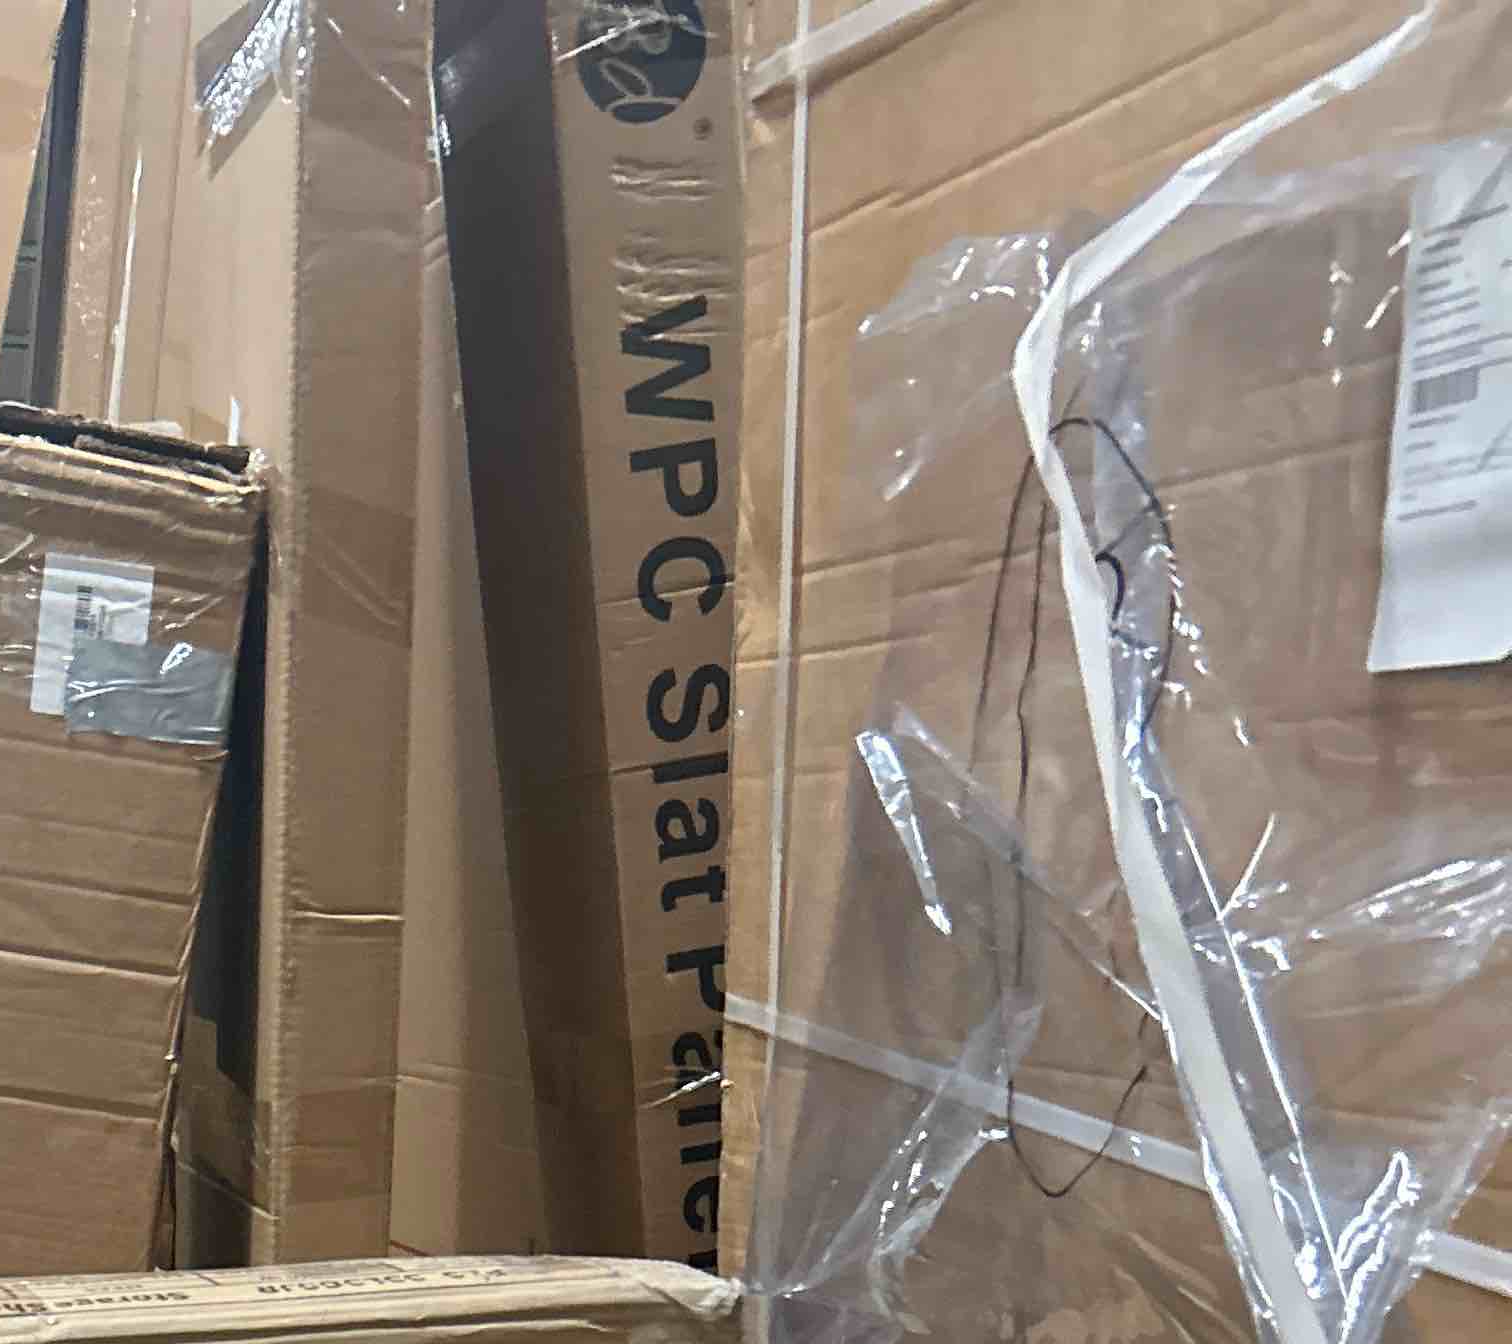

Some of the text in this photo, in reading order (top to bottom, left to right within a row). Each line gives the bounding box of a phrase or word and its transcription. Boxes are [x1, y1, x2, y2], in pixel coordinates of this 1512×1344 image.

[620, 295, 728, 623] WPC
[646, 663, 730, 912] Slat
[57, 1290, 191, 1309] Storage
